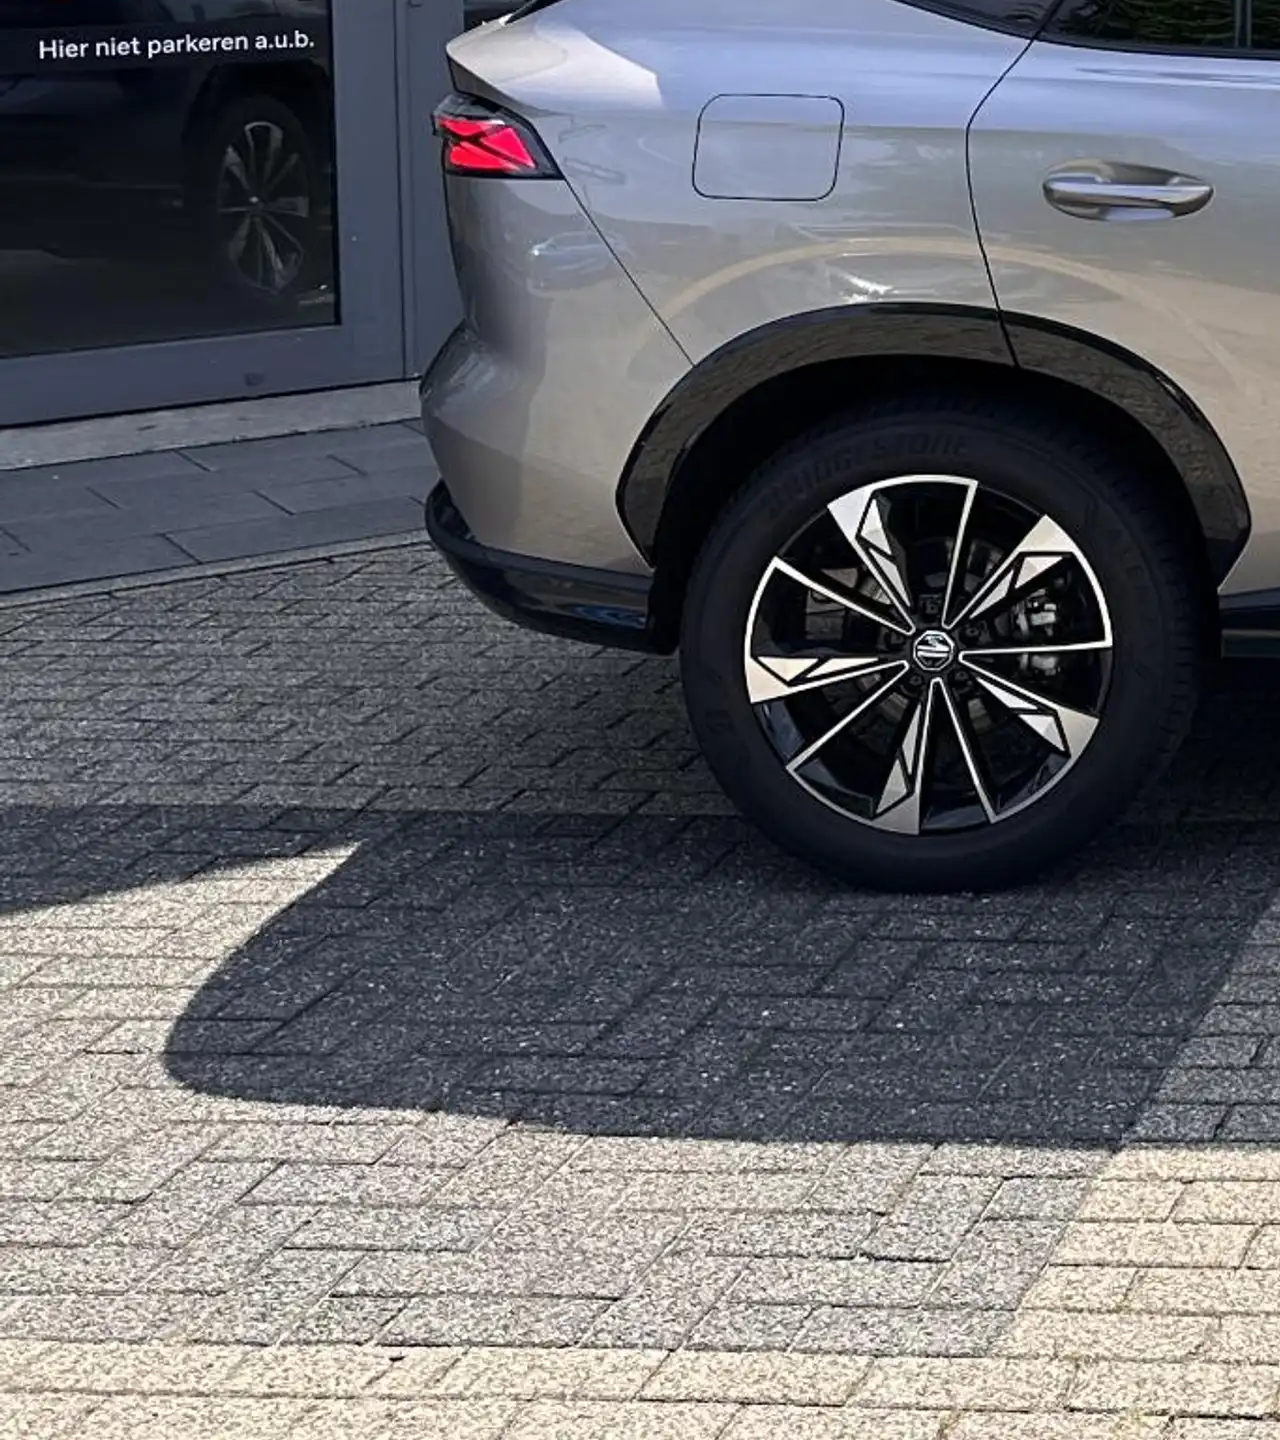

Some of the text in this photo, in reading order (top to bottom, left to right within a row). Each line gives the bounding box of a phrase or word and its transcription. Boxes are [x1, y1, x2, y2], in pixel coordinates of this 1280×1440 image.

[38, 29, 316, 60] Hier niet parkeren a.u.b.
